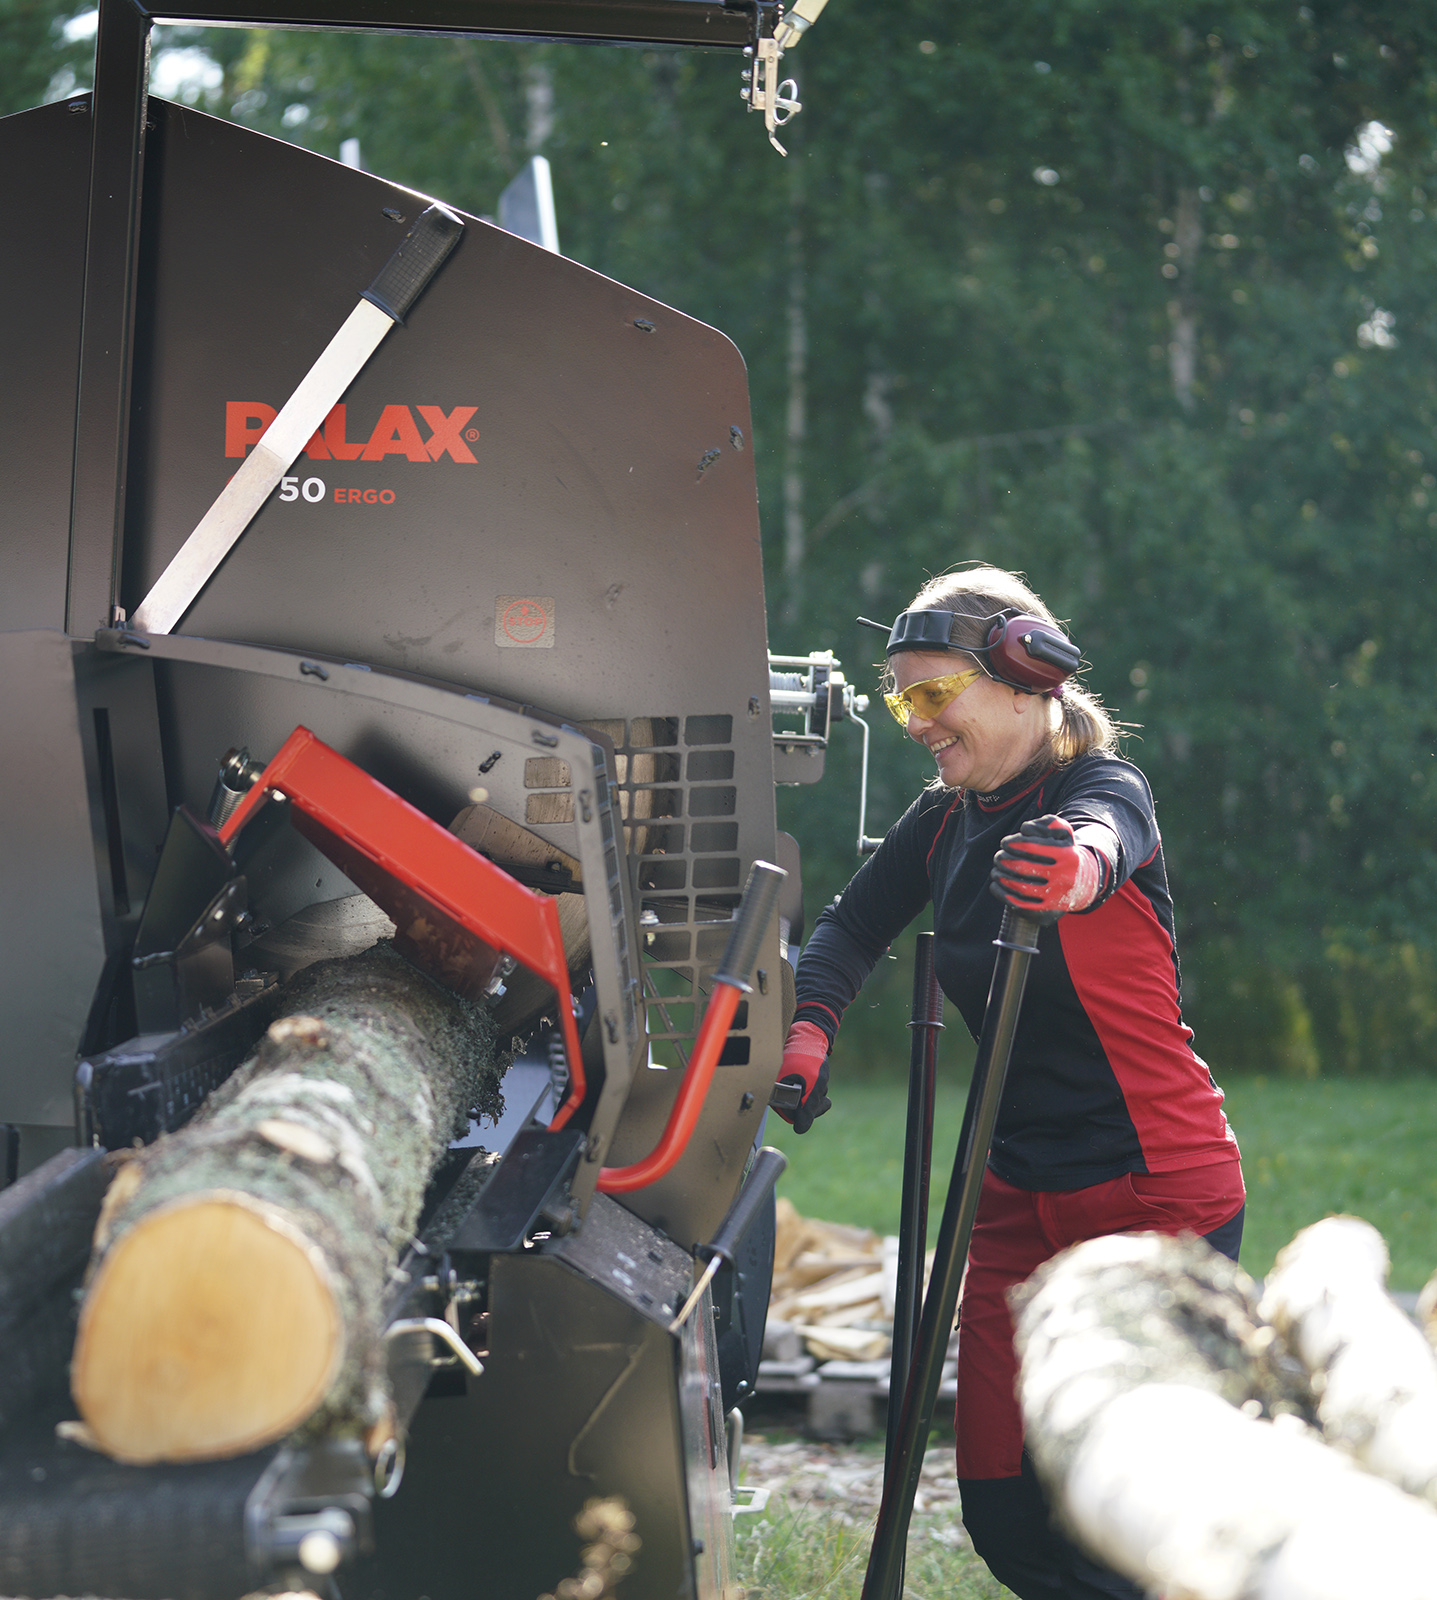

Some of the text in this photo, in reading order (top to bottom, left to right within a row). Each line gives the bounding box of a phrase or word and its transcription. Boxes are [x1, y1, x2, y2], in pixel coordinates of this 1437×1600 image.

[278, 476, 396, 504] 50 ERGO
[508, 616, 542, 626] STOP
